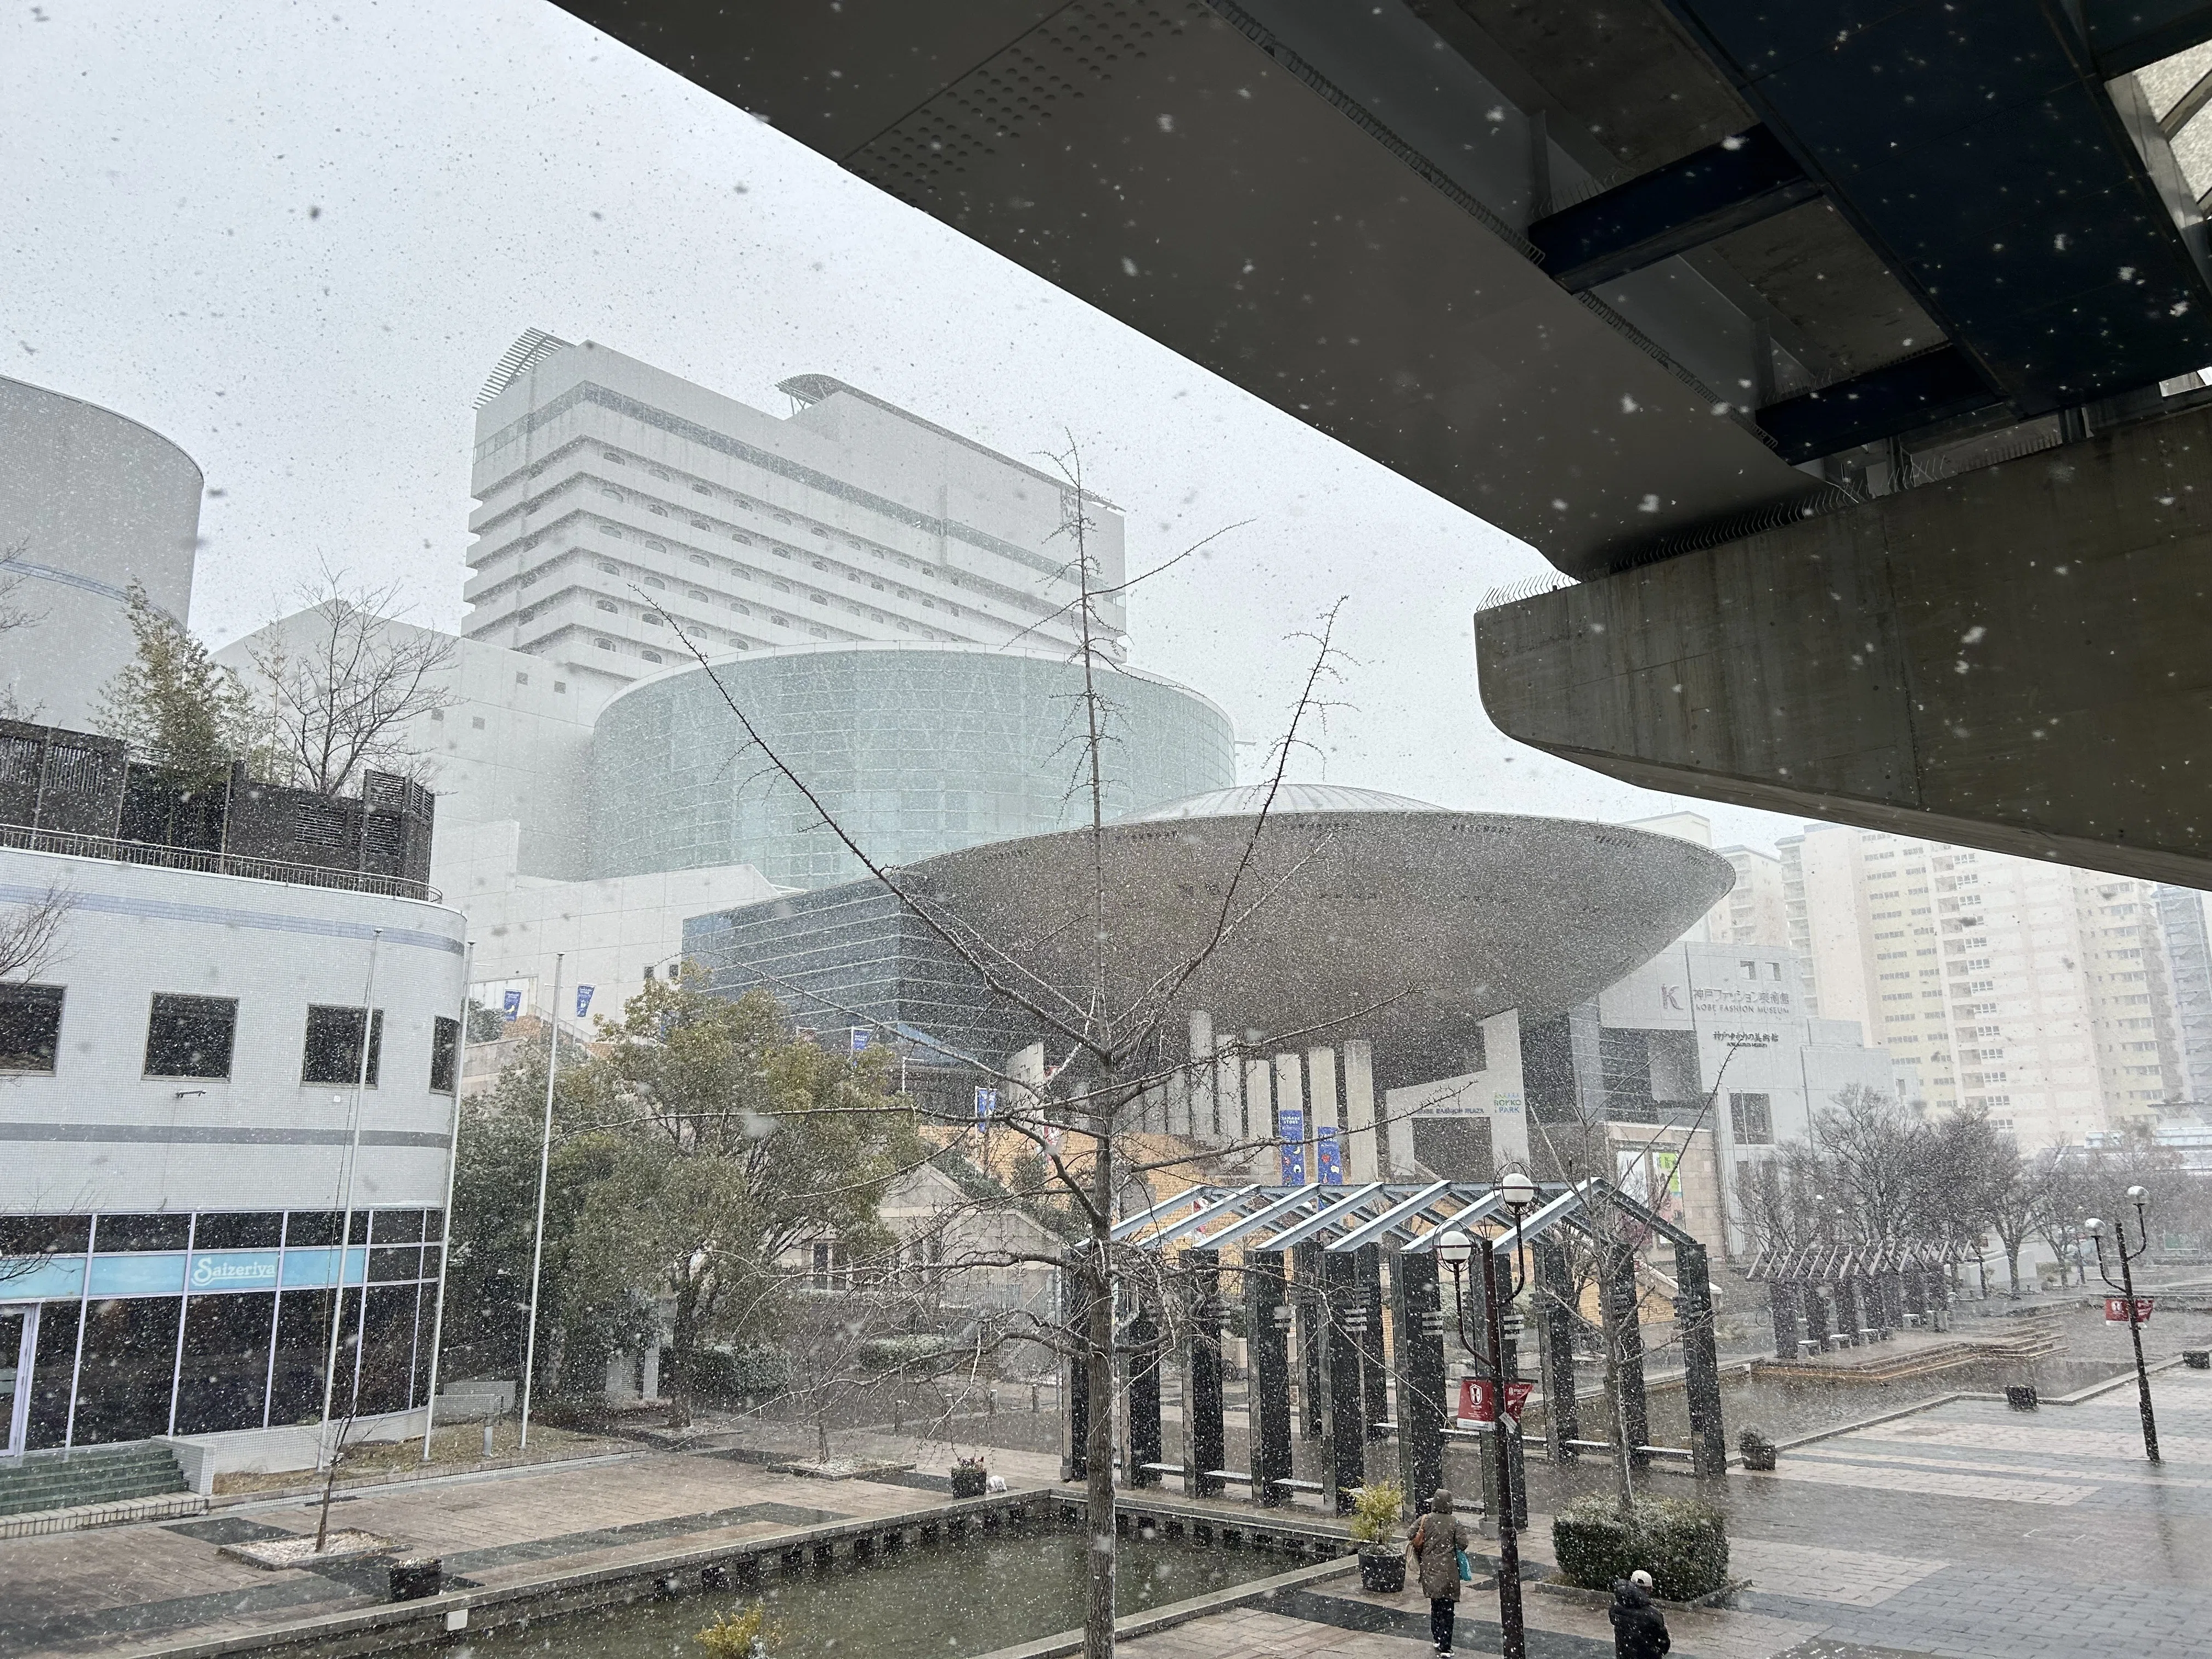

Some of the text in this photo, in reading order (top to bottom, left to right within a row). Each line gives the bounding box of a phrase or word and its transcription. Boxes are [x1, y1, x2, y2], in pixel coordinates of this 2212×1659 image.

[1696, 1003, 1789, 1014] KOBE FASHION MUSEUM
[193, 1257, 275, 1284] Saizeriya
